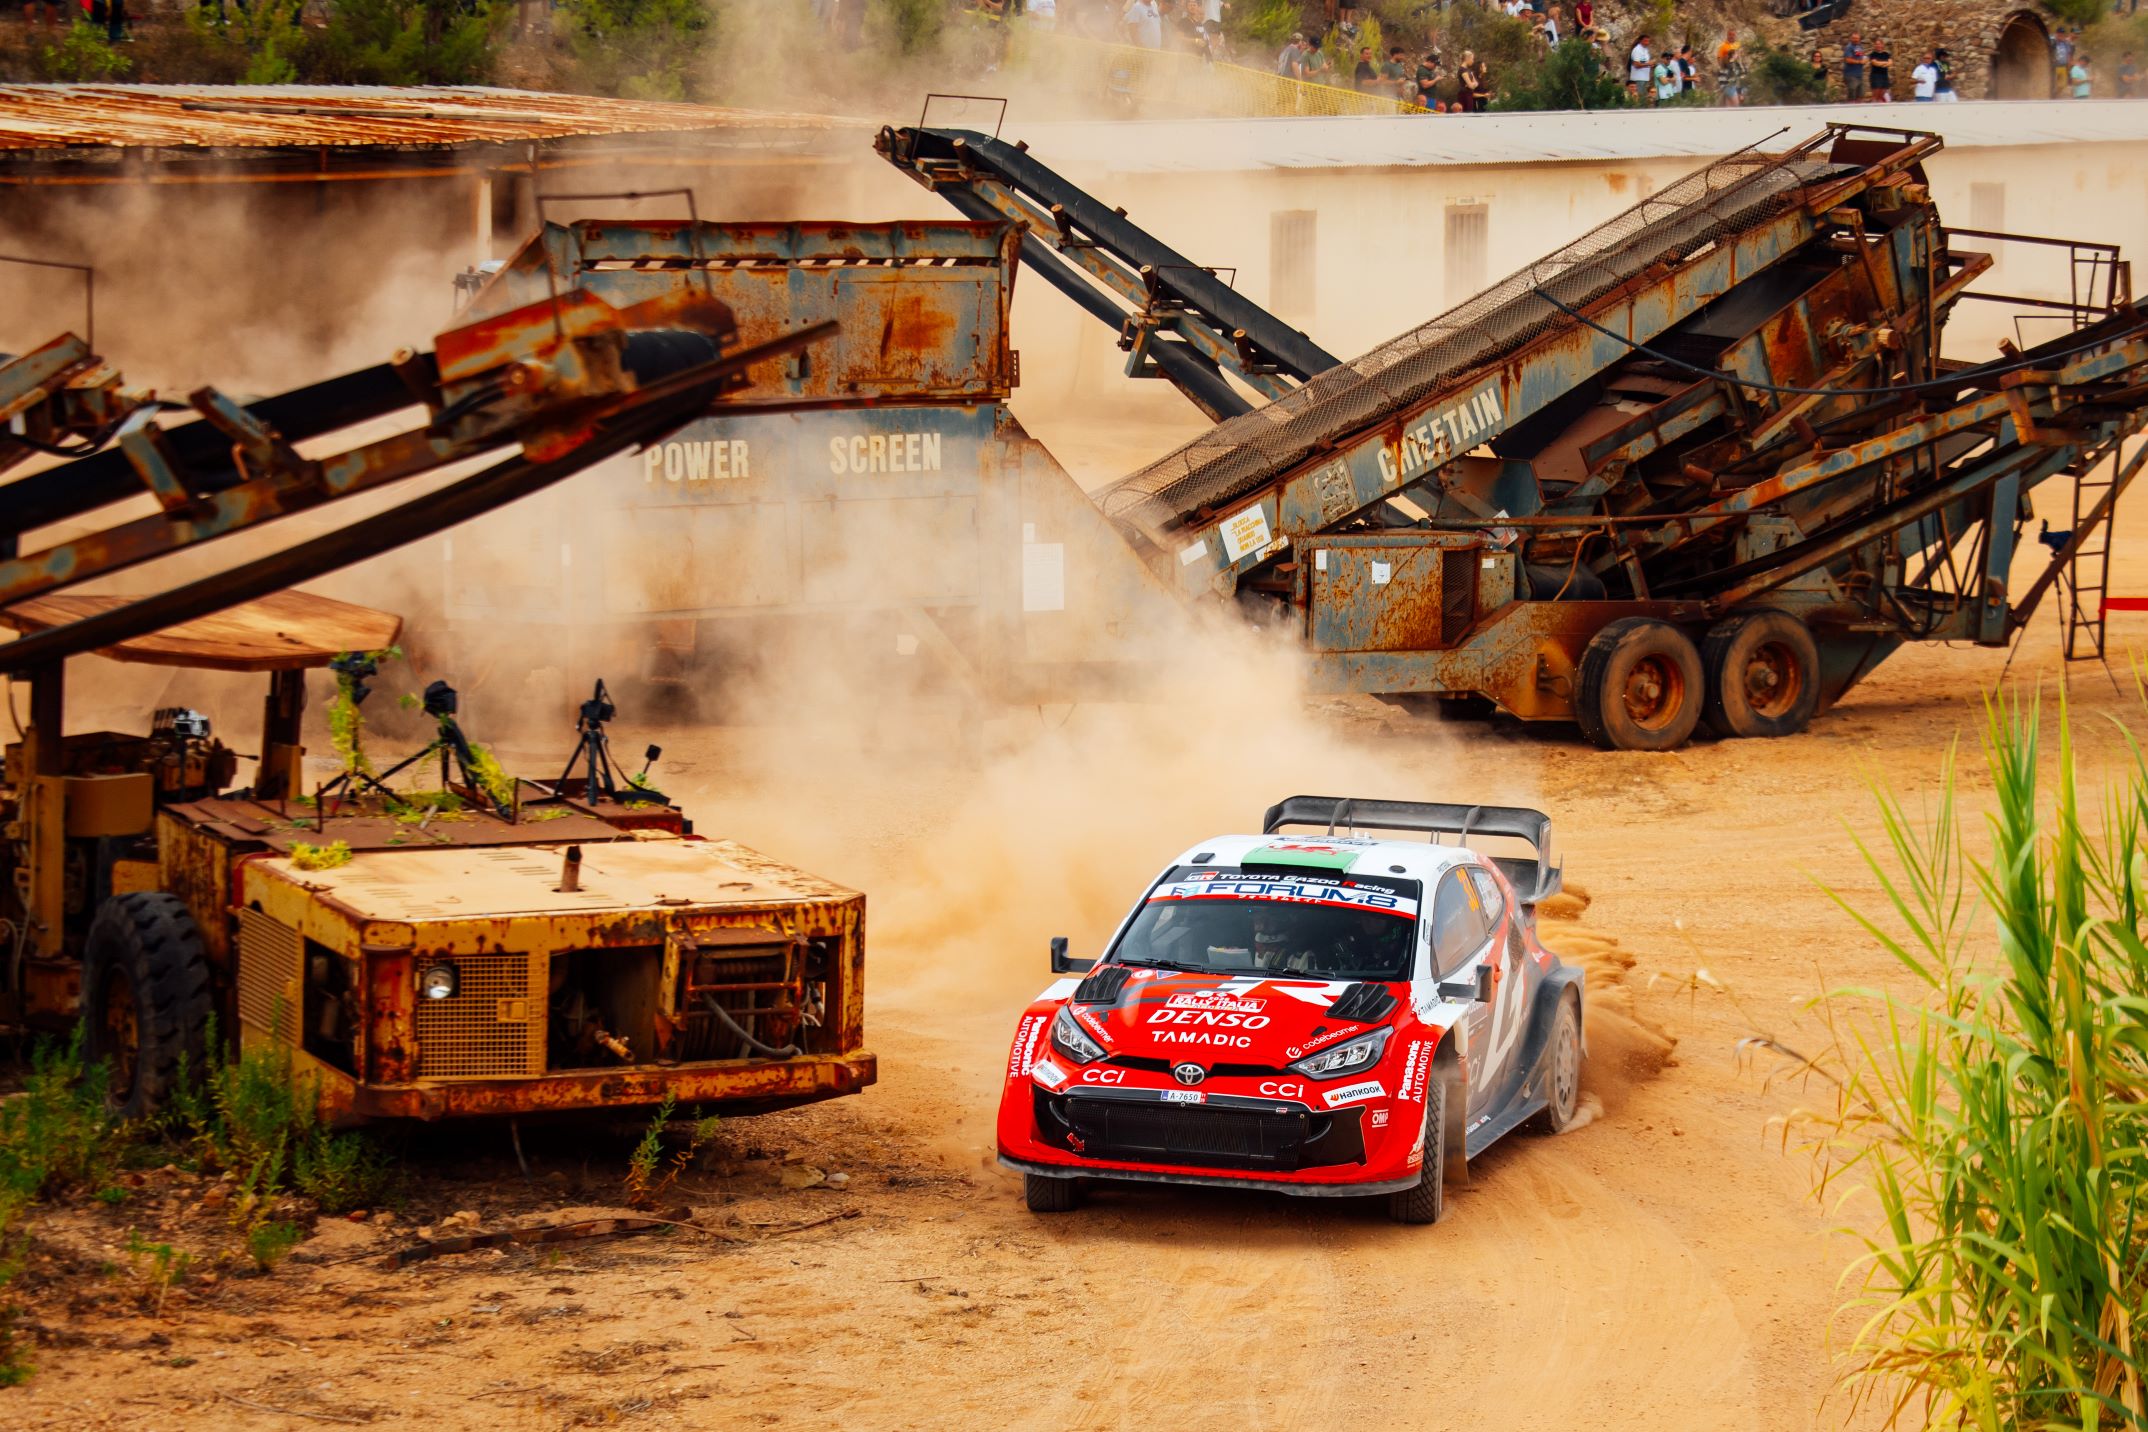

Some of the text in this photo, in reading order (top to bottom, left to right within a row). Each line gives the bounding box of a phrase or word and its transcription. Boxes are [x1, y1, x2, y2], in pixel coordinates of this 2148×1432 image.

[1377, 387, 1502, 482] CHIEFTAIN
[644, 432, 941, 482] POWER SCREEN
[1205, 883, 1398, 909] FORUM8
[1220, 873, 1280, 881] TOYOTA
[1343, 880, 1395, 895] Racing
[1175, 997, 1214, 1006] RALLY
[1217, 1000, 1258, 1009] ITALIA
[1146, 1009, 1271, 1030] DENSO
[1009, 1016, 1033, 1078] AUTOMOTIVE
[1021, 1016, 1047, 1076] Panasonic
[1151, 1031, 1252, 1048] TAMADIC
[1303, 1025, 1358, 1049] codebeamer
[1398, 1040, 1421, 1100] Panasonic
[1412, 1041, 1434, 1103] AUTOMOTIVE
[1170, 1092, 1198, 1101] A-7650
[1372, 1113, 1389, 1124] OMP
